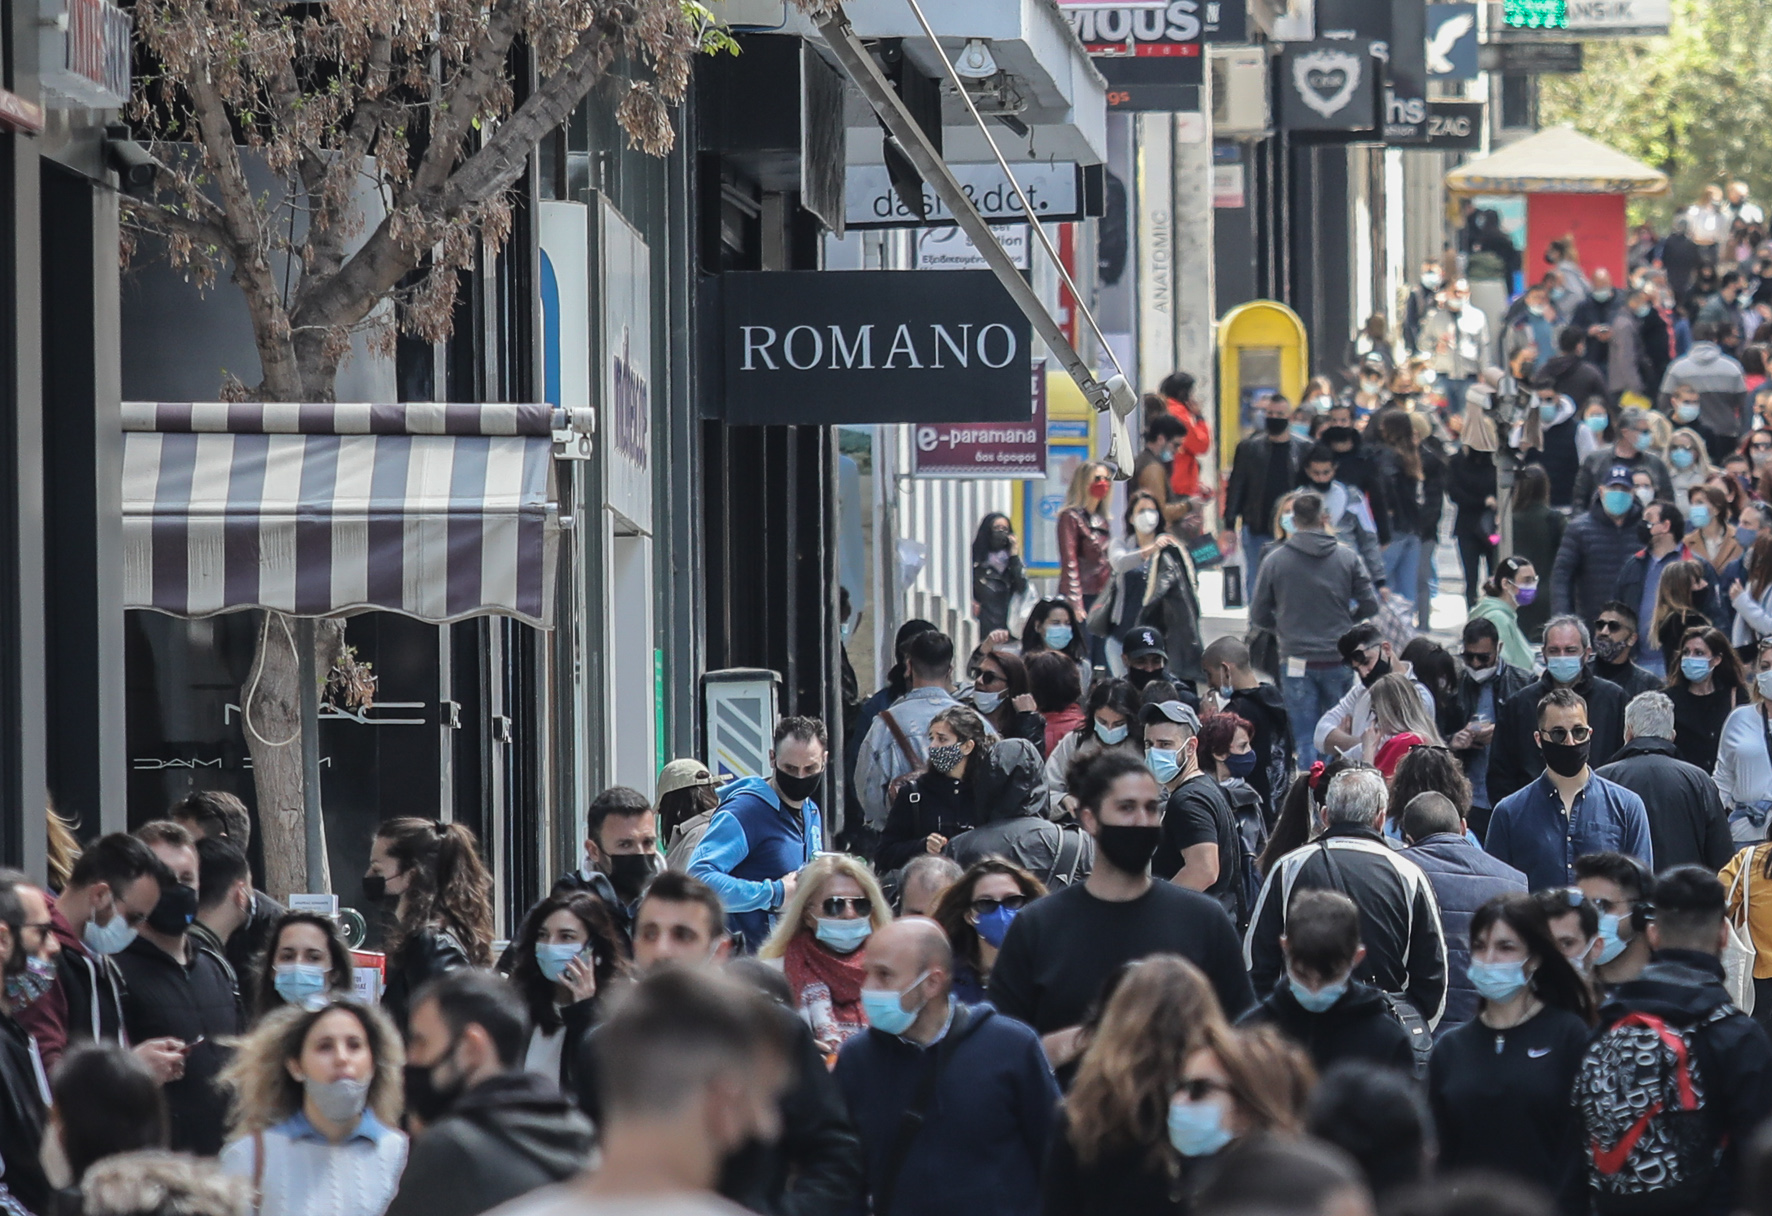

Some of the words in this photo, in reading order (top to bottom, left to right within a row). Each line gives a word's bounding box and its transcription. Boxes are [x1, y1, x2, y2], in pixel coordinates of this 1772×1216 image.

[1428, 115, 1471, 137] ZAC
[1151, 209, 1169, 314] ANATOMIC
[739, 323, 1017, 370] ROMANO
[918, 427, 1037, 452] e-paramana
